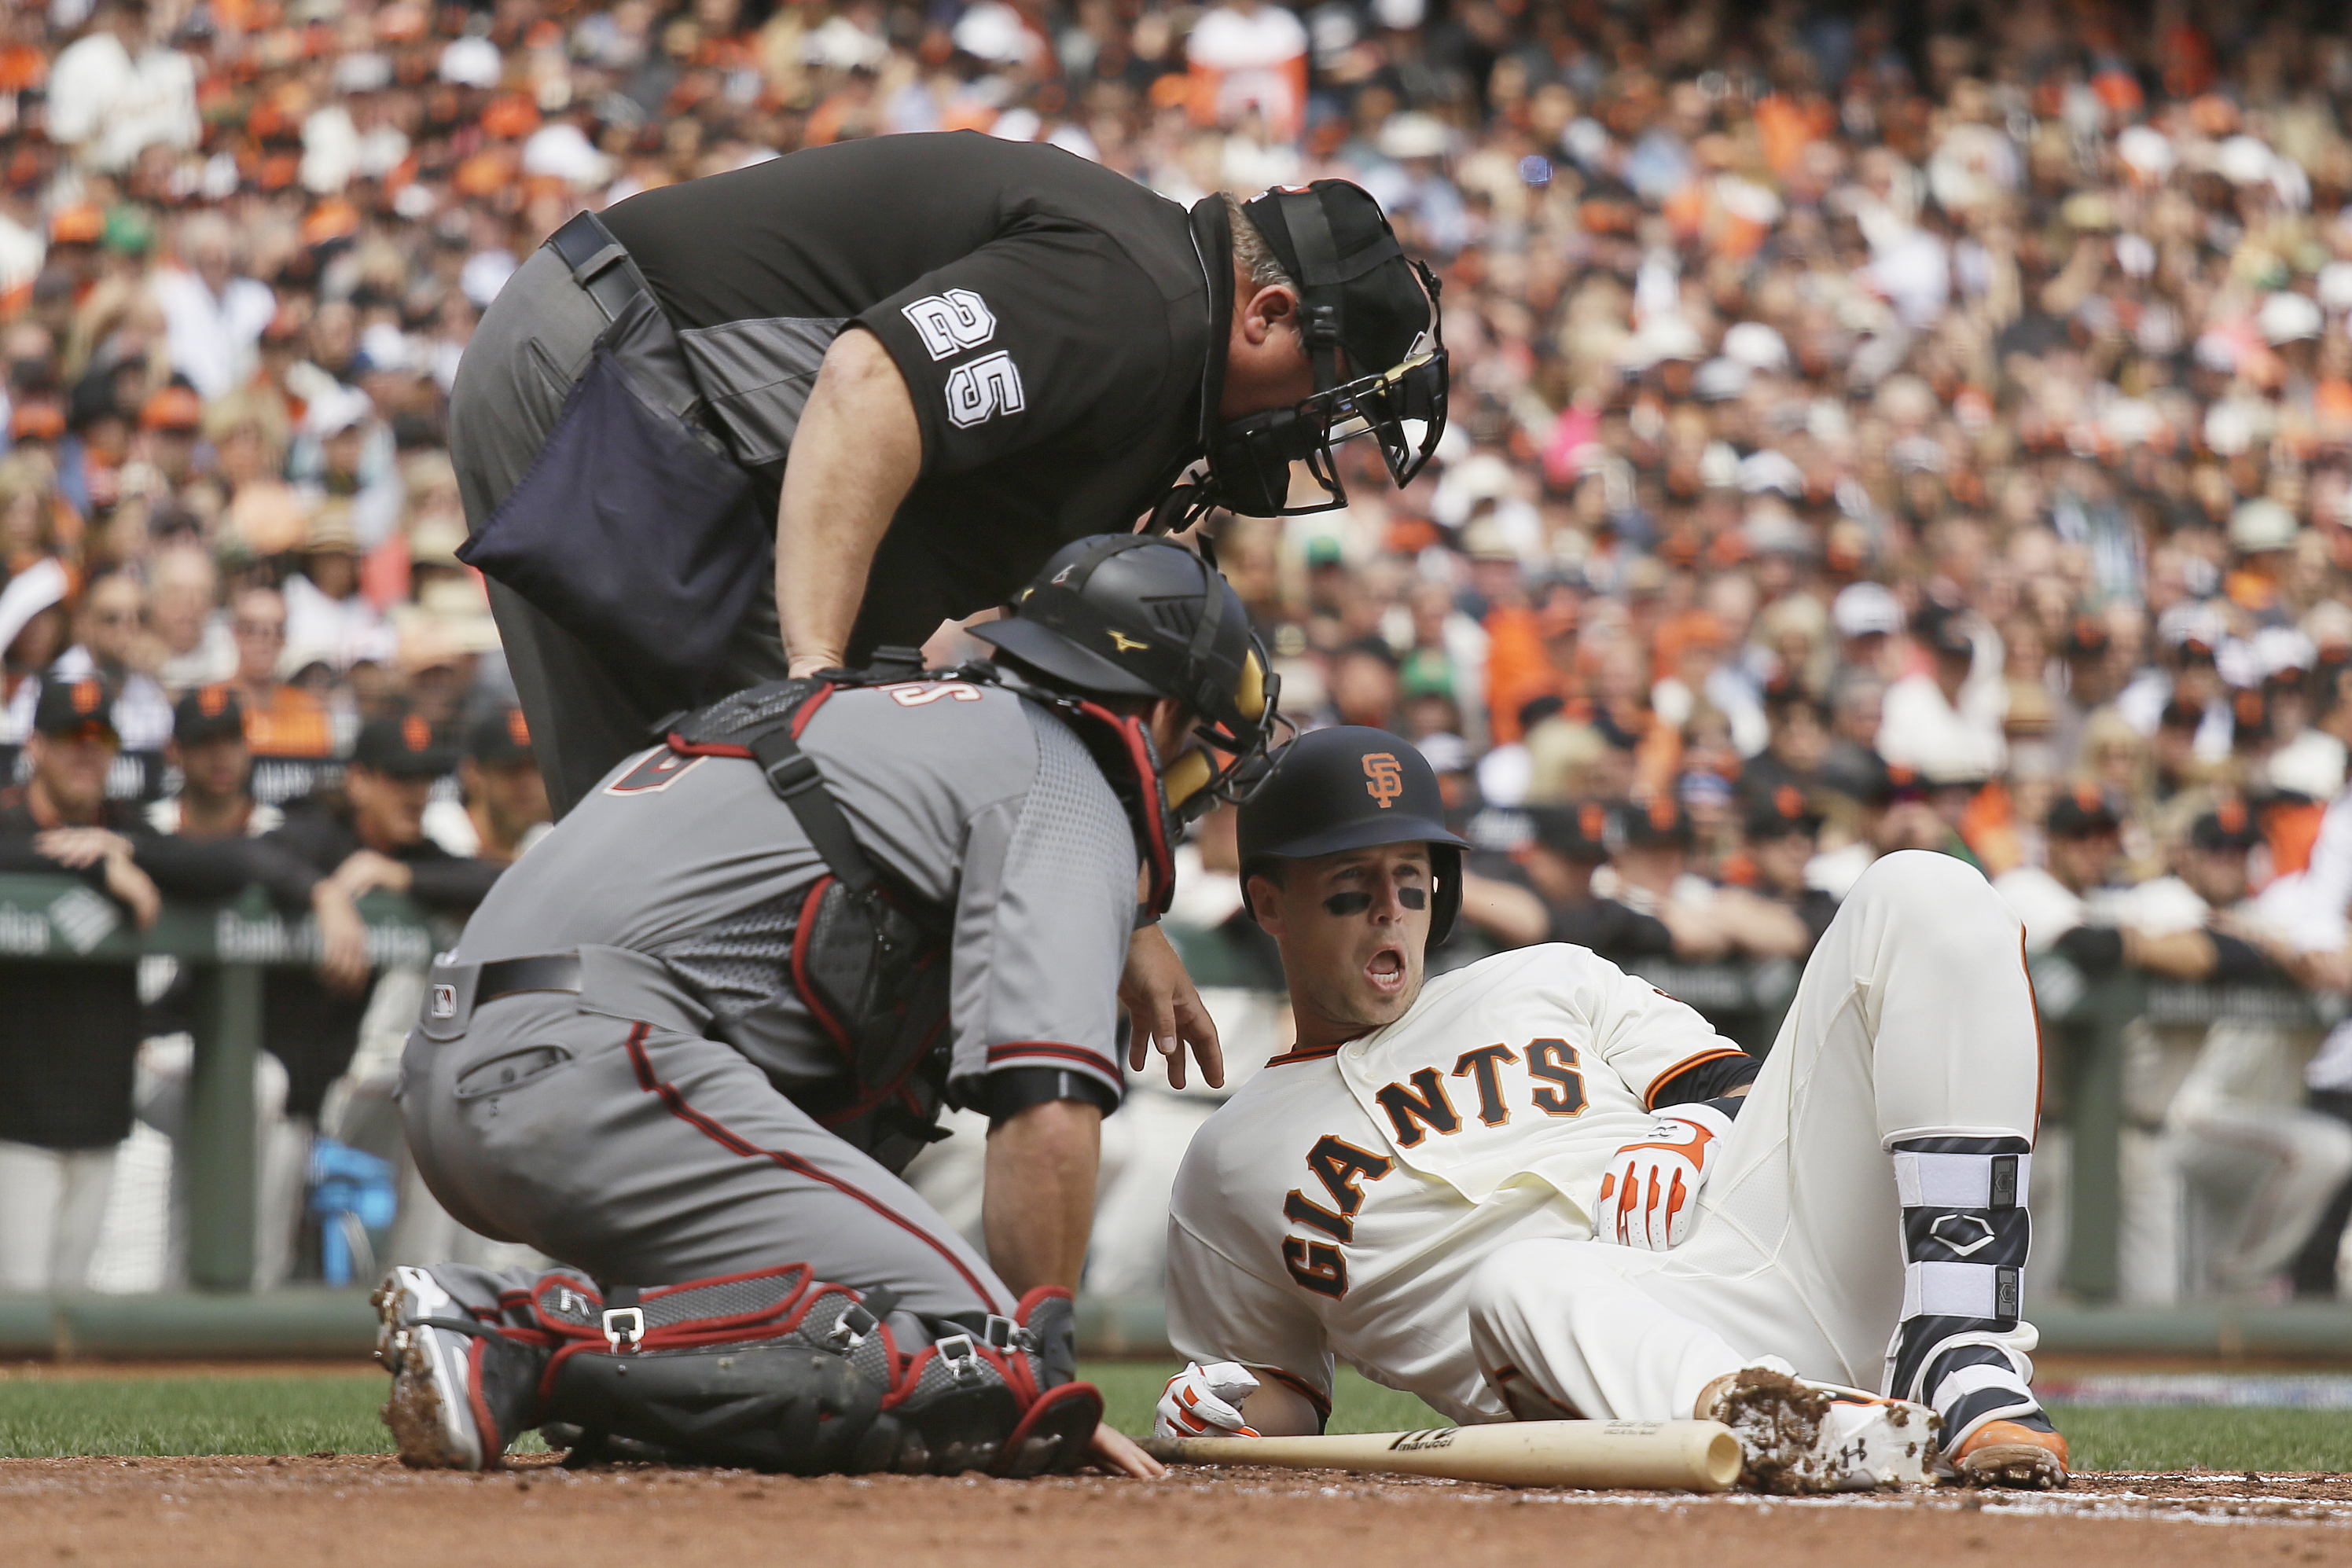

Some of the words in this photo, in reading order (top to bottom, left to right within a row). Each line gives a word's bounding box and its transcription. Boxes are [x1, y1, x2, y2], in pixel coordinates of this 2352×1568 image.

[901, 288, 1026, 429] 25
[876, 674, 983, 707] S
[1361, 752, 1403, 808] SF
[1281, 1037, 1590, 1302] GIANTS
[1398, 1437, 1455, 1451] marucci
